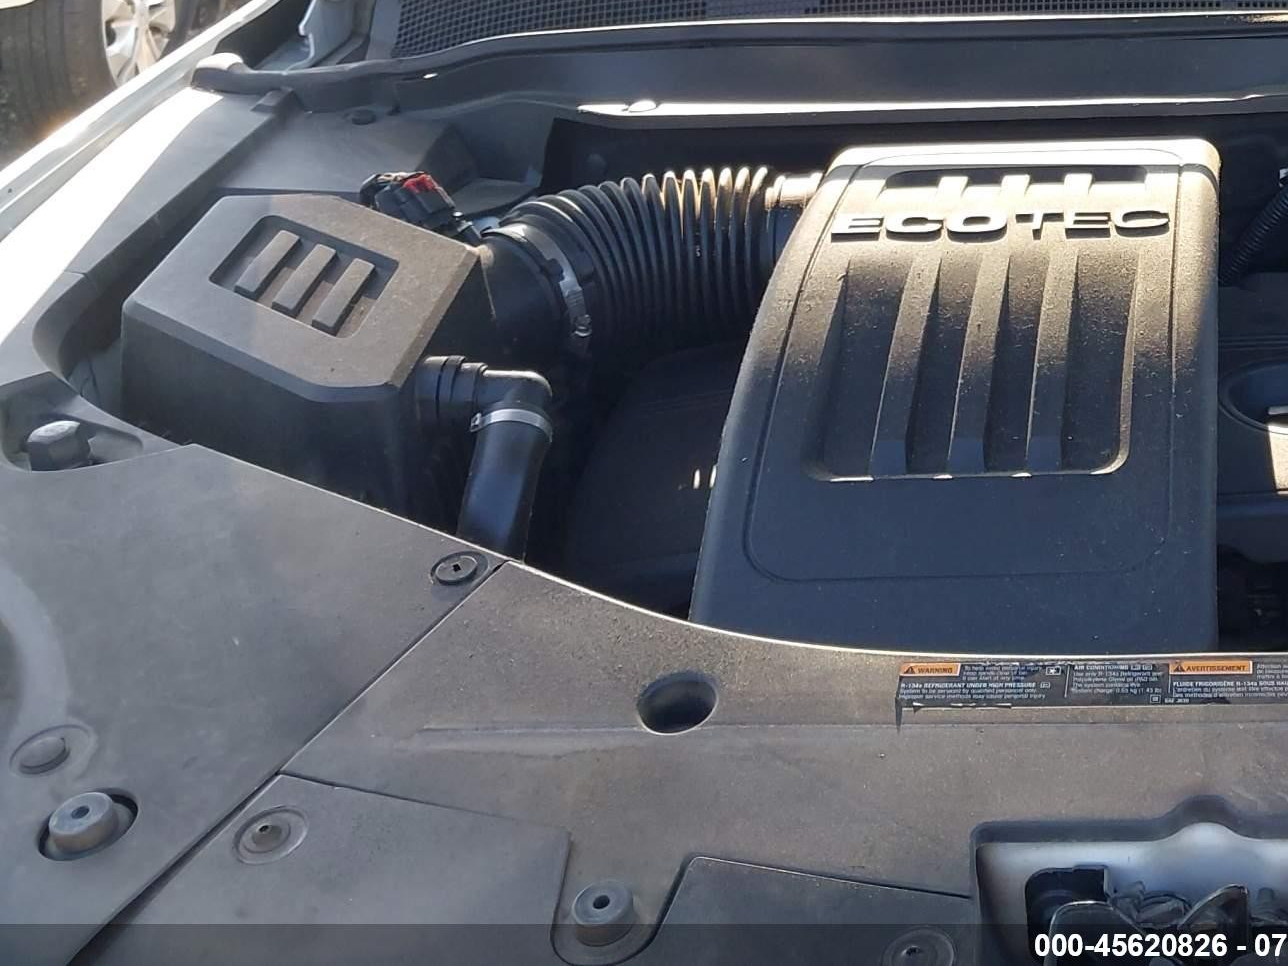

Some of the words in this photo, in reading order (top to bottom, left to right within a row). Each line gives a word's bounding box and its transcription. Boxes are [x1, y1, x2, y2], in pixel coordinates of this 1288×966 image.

[830, 209, 1170, 243] ECOTEC
[917, 667, 953, 675] WARNING
[1187, 665, 1245, 673] AVERTISSEMENT
